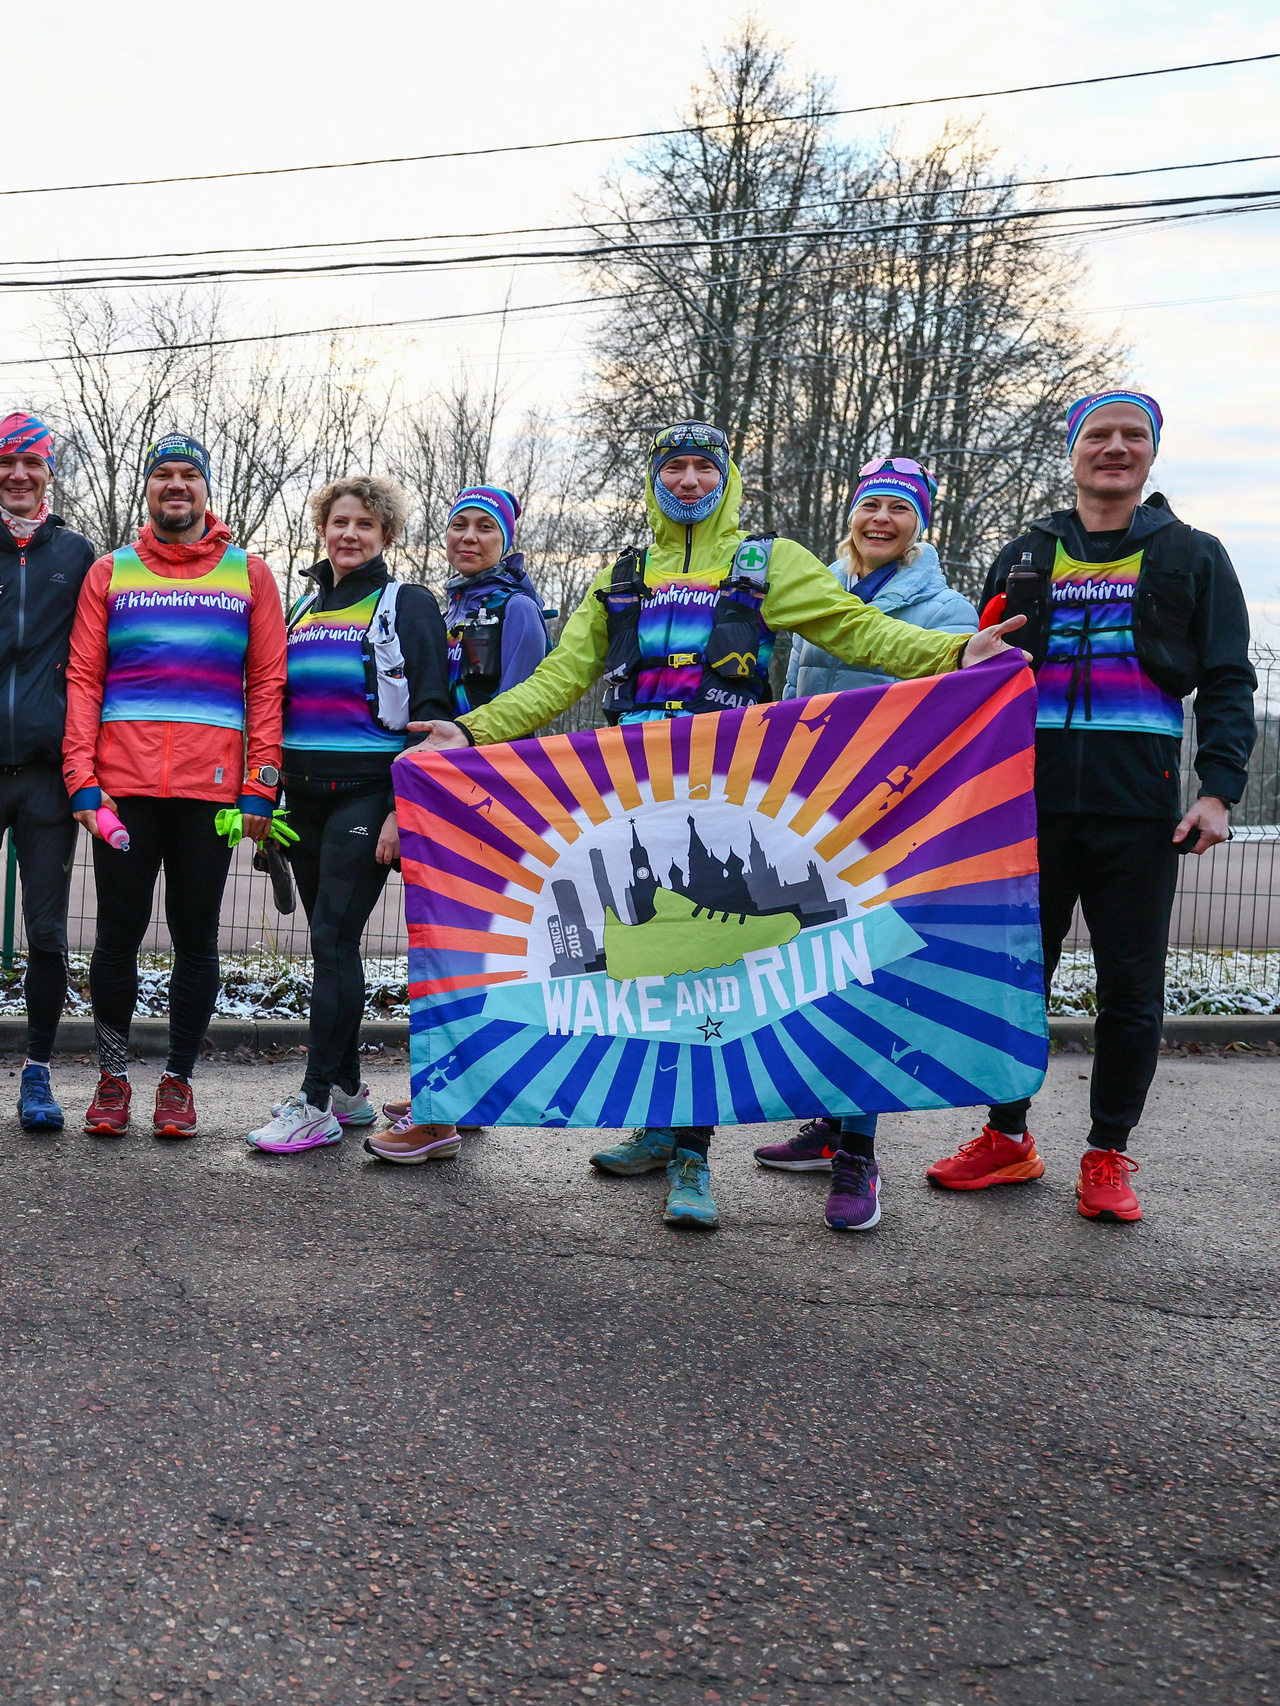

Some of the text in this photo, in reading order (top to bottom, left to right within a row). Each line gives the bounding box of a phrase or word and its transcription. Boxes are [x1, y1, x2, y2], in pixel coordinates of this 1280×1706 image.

[864, 477, 918, 493] #khimkirunbar
[115, 590, 248, 614] #khimkirunbar
[549, 920, 565, 955] SINCE
[565, 924, 584, 959] 2015
[541, 921, 875, 1036] WAKE AND RUN
